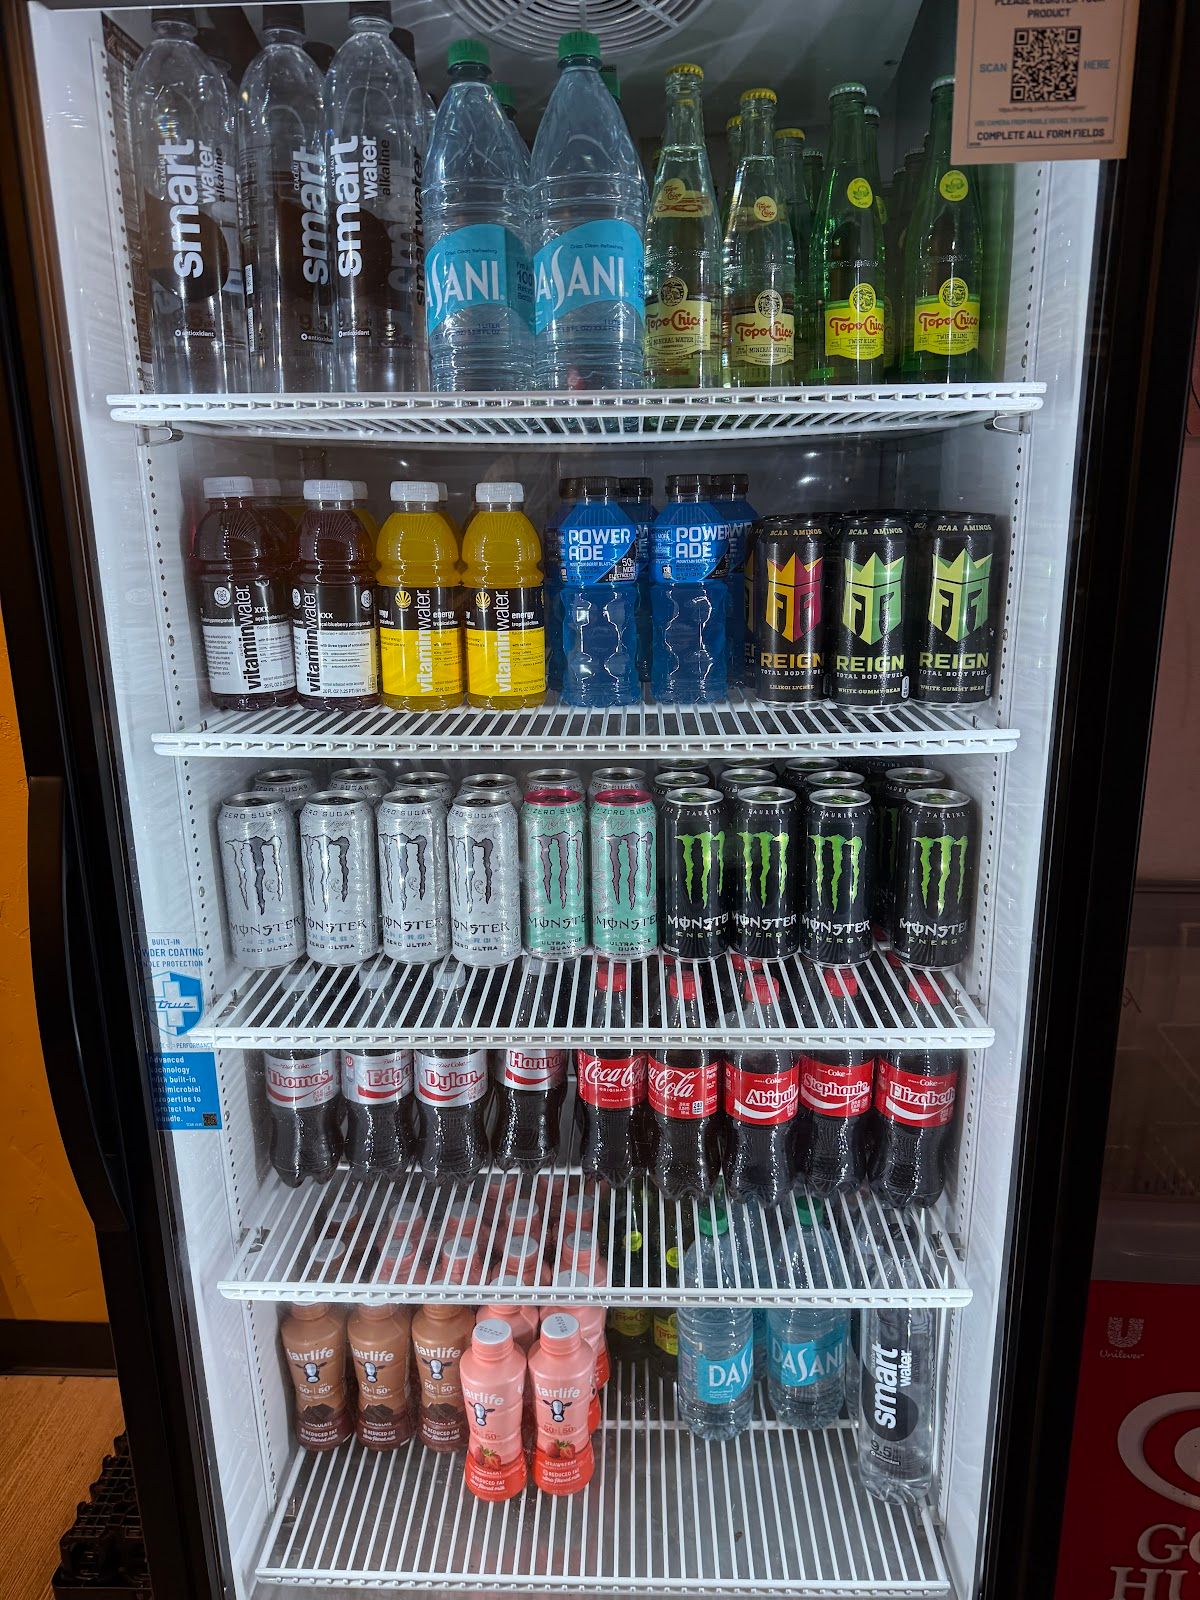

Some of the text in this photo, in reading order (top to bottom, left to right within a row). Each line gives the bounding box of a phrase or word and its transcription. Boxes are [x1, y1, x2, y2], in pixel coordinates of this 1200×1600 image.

[1027, 8, 1072, 18] PRODUCT
[980, 63, 1007, 73] SCAN
[1083, 60, 1111, 70] HERE
[977, 128, 1105, 141] COMPLETE ALL FORM FIELDS
[197, 140, 216, 204] water
[360, 135, 378, 199] water
[378, 139, 390, 196] alkaline
[216, 147, 226, 202] alkaline
[159, 138, 203, 278] smart
[331, 136, 362, 278] smart
[293, 146, 328, 285] smart
[411, 147, 426, 307] smartwater
[829, 316, 865, 336] Topo
[919, 309, 978, 331] Topo Chico
[735, 322, 770, 342] Topo
[675, 335, 694, 344] WATER
[770, 528, 822, 537] BCAA AMINOS
[849, 527, 903, 536] BCAA AMINOS
[937, 524, 992, 532] BCAA AMINOS
[569, 528, 631, 545] POWER
[569, 545, 604, 560] ADE
[675, 542, 712, 558] ADE
[433, 610, 455, 619] energy
[512, 611, 535, 619] energy
[234, 585, 262, 691] vitaminwater
[303, 588, 320, 692] vitaminwater
[414, 589, 433, 693] vitaminwater
[493, 590, 512, 693] vitaminwater
[760, 652, 824, 668] REIGN
[836, 654, 905, 672] REIGN
[919, 651, 989, 669] REIGN
[919, 669, 943, 677] TOTAL
[971, 669, 988, 677] FUEL
[969, 684, 985, 692] BEAR
[224, 807, 282, 819] ZERO SUGAR
[322, 809, 355, 817] SUGAR
[400, 808, 433, 817] SUGAR
[467, 811, 499, 819] SUGAR
[533, 805, 582, 815] ZERO SUGAR
[602, 805, 654, 816] ZERO SUGAR
[686, 808, 720, 817] TAURINE
[819, 810, 858, 819] TAURINE
[927, 811, 966, 820] TAURINE
[230, 917, 300, 937] MONSTER
[453, 918, 510, 935] ONSTER
[528, 914, 585, 930] MONSTE
[596, 914, 657, 931] MONSTE
[667, 912, 729, 931] MONSTE
[732, 911, 797, 931] MONSTER
[802, 915, 871, 936] MONSTER
[899, 917, 967, 938] MONSTE
[676, 927, 727, 939] ENERGY
[738, 927, 791, 938] ENERGY
[808, 933, 863, 944] ENERGY
[152, 938, 180, 946] BUILT-IN
[267, 942, 293, 952] ULTRA
[309, 941, 324, 949] ZERO
[386, 938, 403, 947] ZERO
[454, 941, 469, 950] ZERO
[908, 936, 963, 946] ENERGY
[168, 948, 204, 957] COATING
[162, 960, 203, 968] PROTECTION
[268, 1067, 330, 1089] Thomas
[367, 1065, 414, 1087] Edga
[827, 1069, 846, 1077] Coke
[425, 1069, 478, 1092] Dylan
[765, 1077, 782, 1085] Coke
[804, 1074, 869, 1097] Stephanie
[746, 1084, 798, 1109] Abigail
[890, 1081, 956, 1106] Elizabeth
[1100, 1349, 1144, 1360] Unilever
[898, 1350, 912, 1387] water
[872, 1340, 898, 1429] smart
[535, 1384, 581, 1399] fairlife
[328, 1428, 338, 1436] FAT
[428, 1428, 450, 1436] REDUCED
[474, 1476, 495, 1485] REDUCED
[548, 1470, 571, 1478] REDUCED
